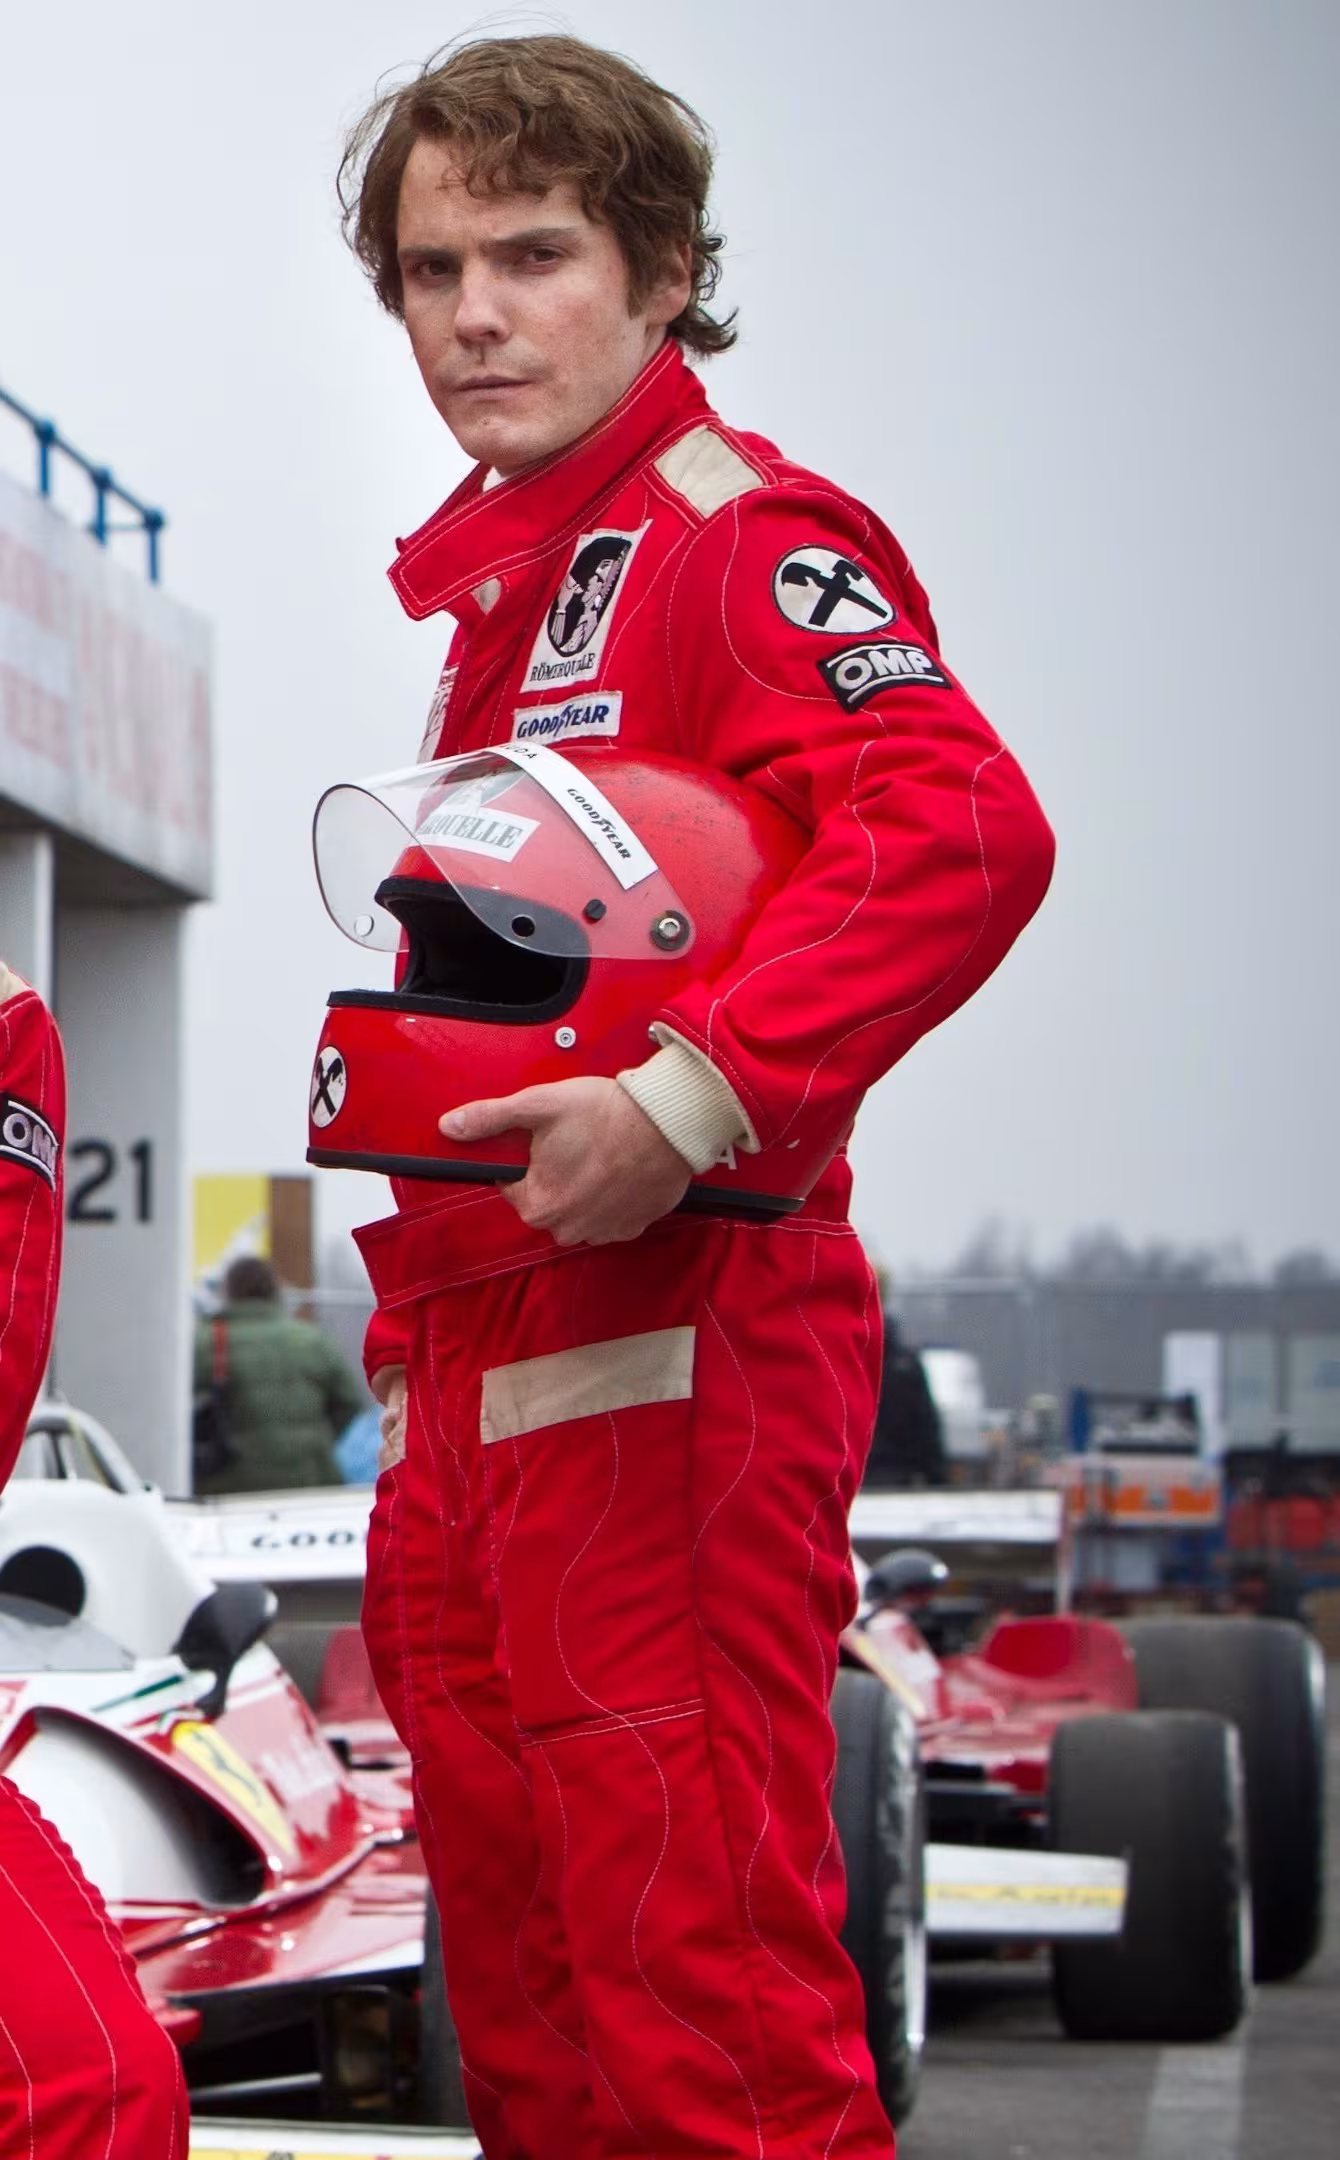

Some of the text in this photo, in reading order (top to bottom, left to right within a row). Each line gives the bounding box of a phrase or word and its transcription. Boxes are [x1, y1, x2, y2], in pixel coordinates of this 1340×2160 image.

[835, 649, 933, 690] OMP
[516, 704, 610, 738] GOODYEAR
[566, 788, 632, 859] GOODYEAR
[2, 1113, 58, 1174] OM
[68, 1137, 153, 1223] 21
